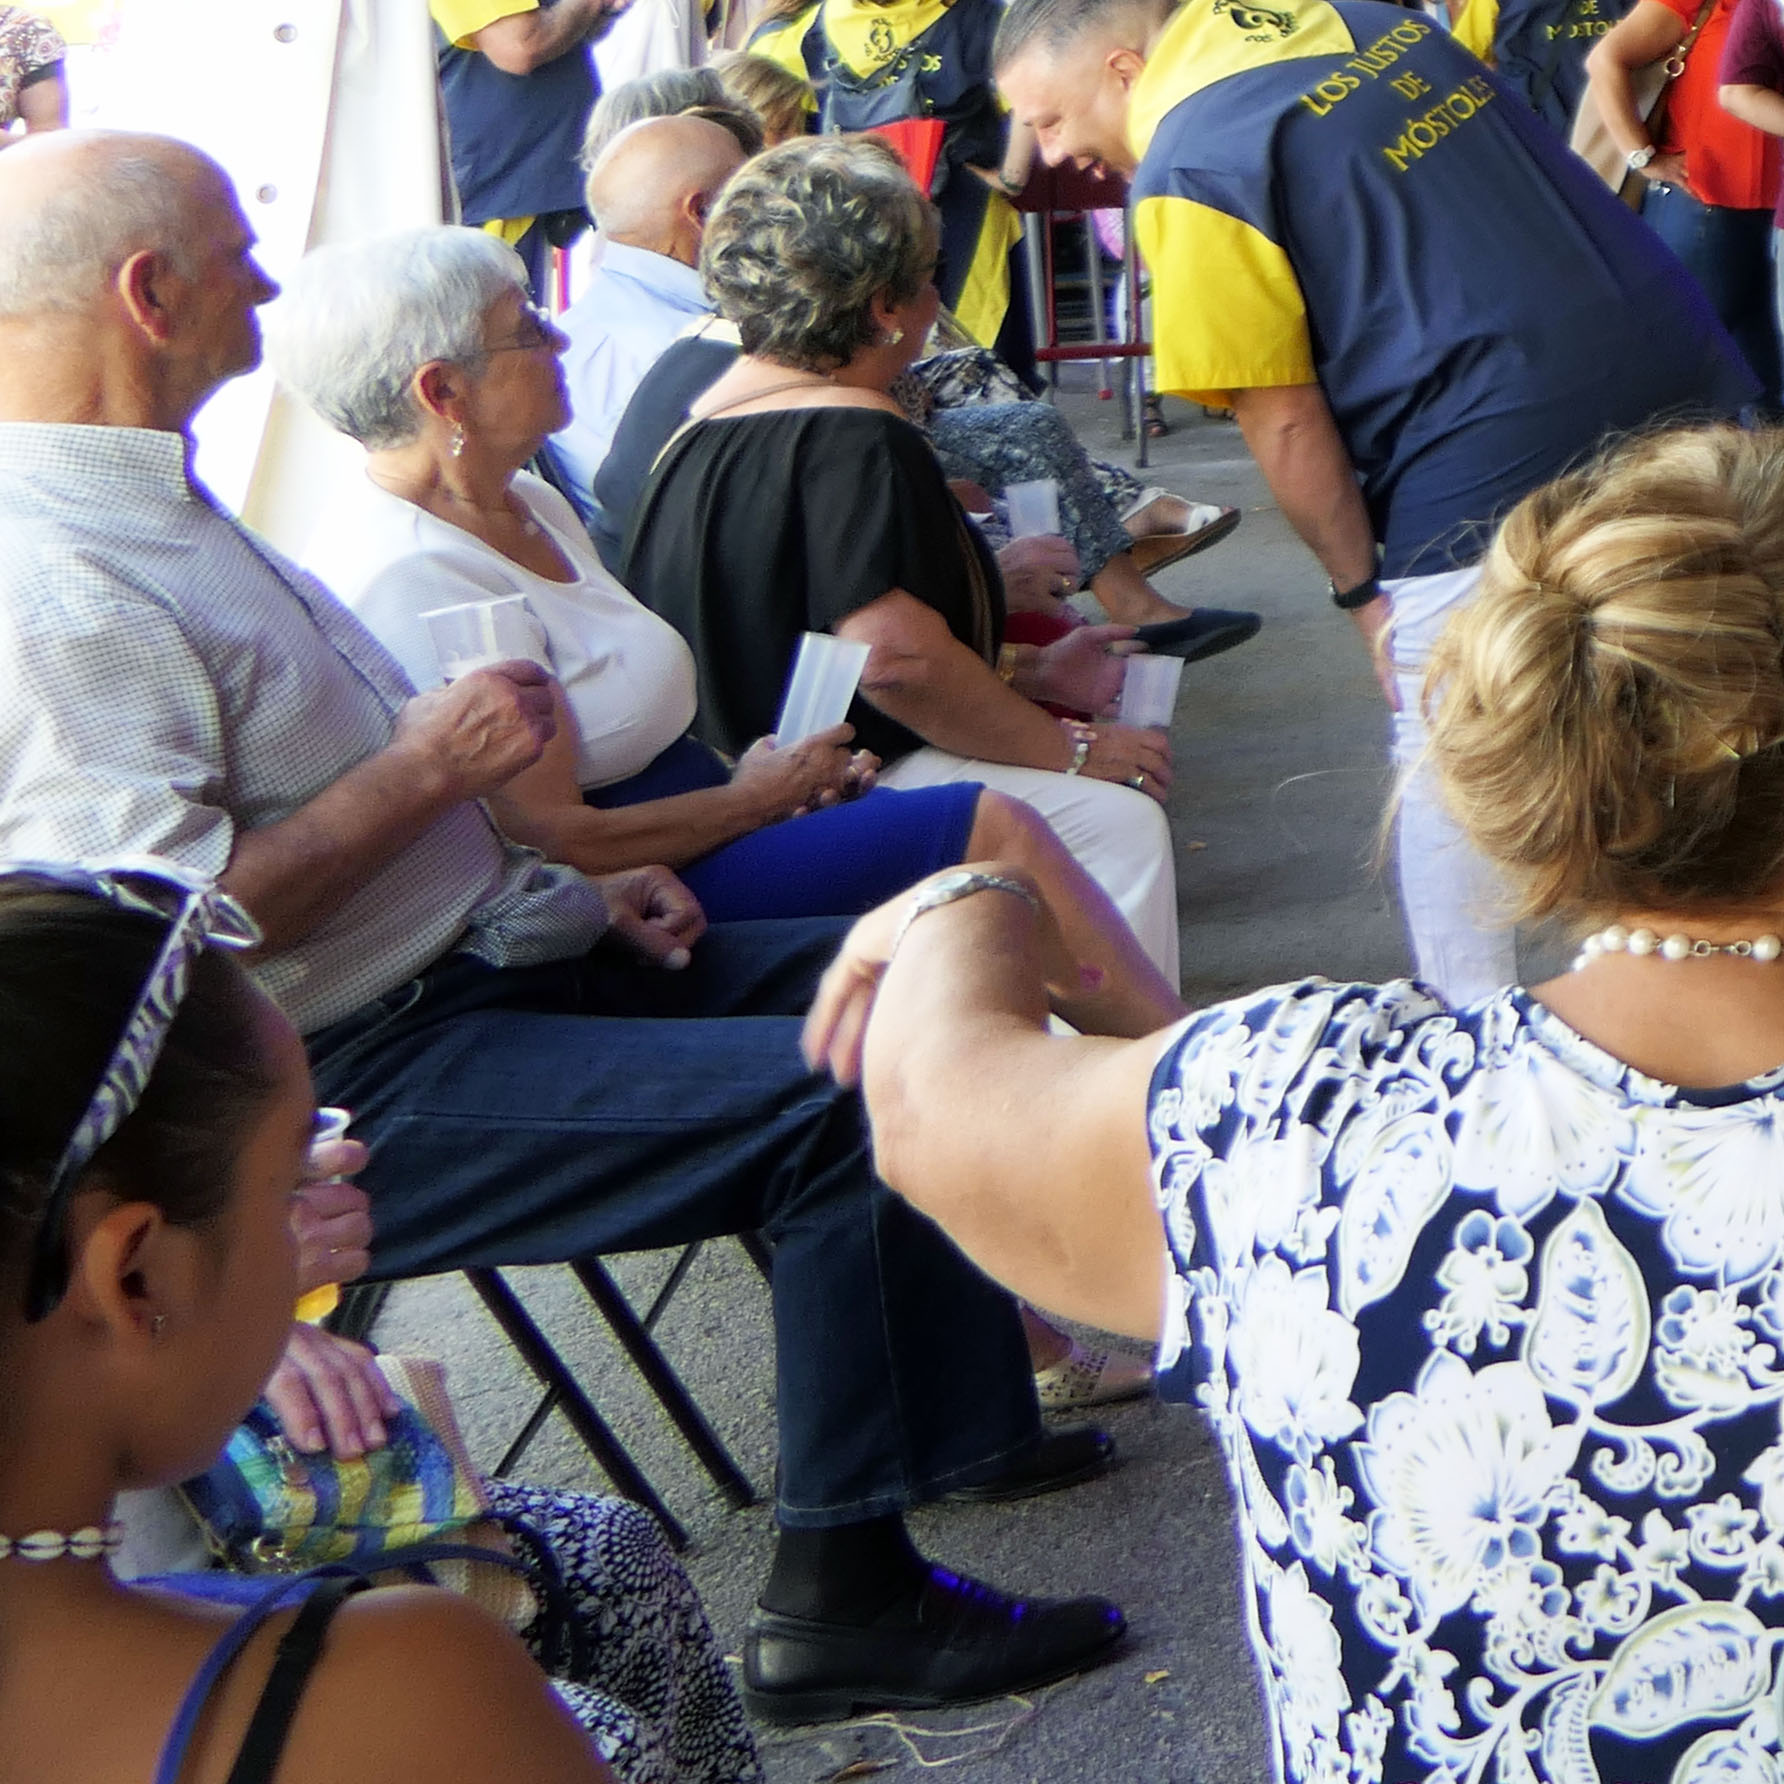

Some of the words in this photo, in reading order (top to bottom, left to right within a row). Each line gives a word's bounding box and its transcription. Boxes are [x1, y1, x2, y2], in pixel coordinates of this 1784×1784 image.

[1300, 71, 1361, 117] LOS
[1347, 18, 1433, 79] JUSTOS
[1390, 71, 1433, 101] DE
